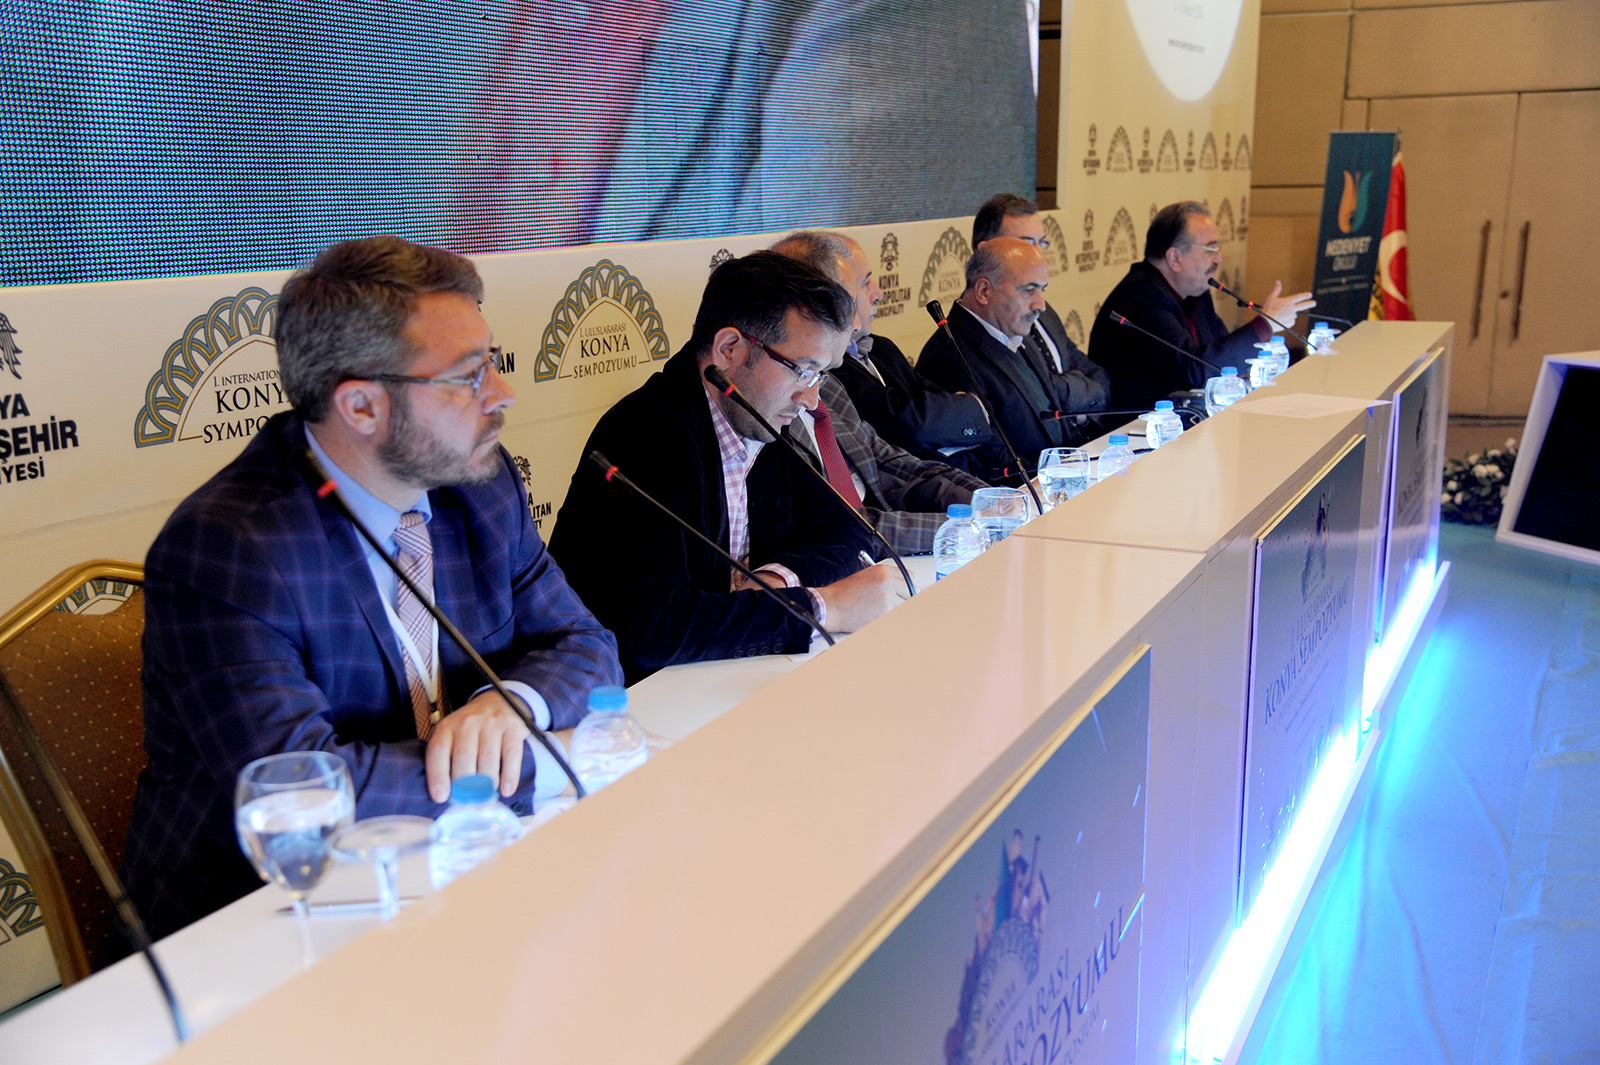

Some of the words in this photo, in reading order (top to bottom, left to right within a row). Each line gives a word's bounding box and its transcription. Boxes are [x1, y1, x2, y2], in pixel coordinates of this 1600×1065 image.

[879, 273, 899, 290] KONYA
[879, 287, 911, 306] OPOLITAN
[585, 323, 626, 337] ULUSLARARASI
[580, 334, 630, 358] KONYA
[574, 355, 637, 378] SEMPOZYUMU
[215, 382, 290, 413] KONY
[0, 456, 45, 485] YESİ
[1265, 653, 1296, 726] KONYA
[1029, 905, 1124, 1065] OZYUMU
